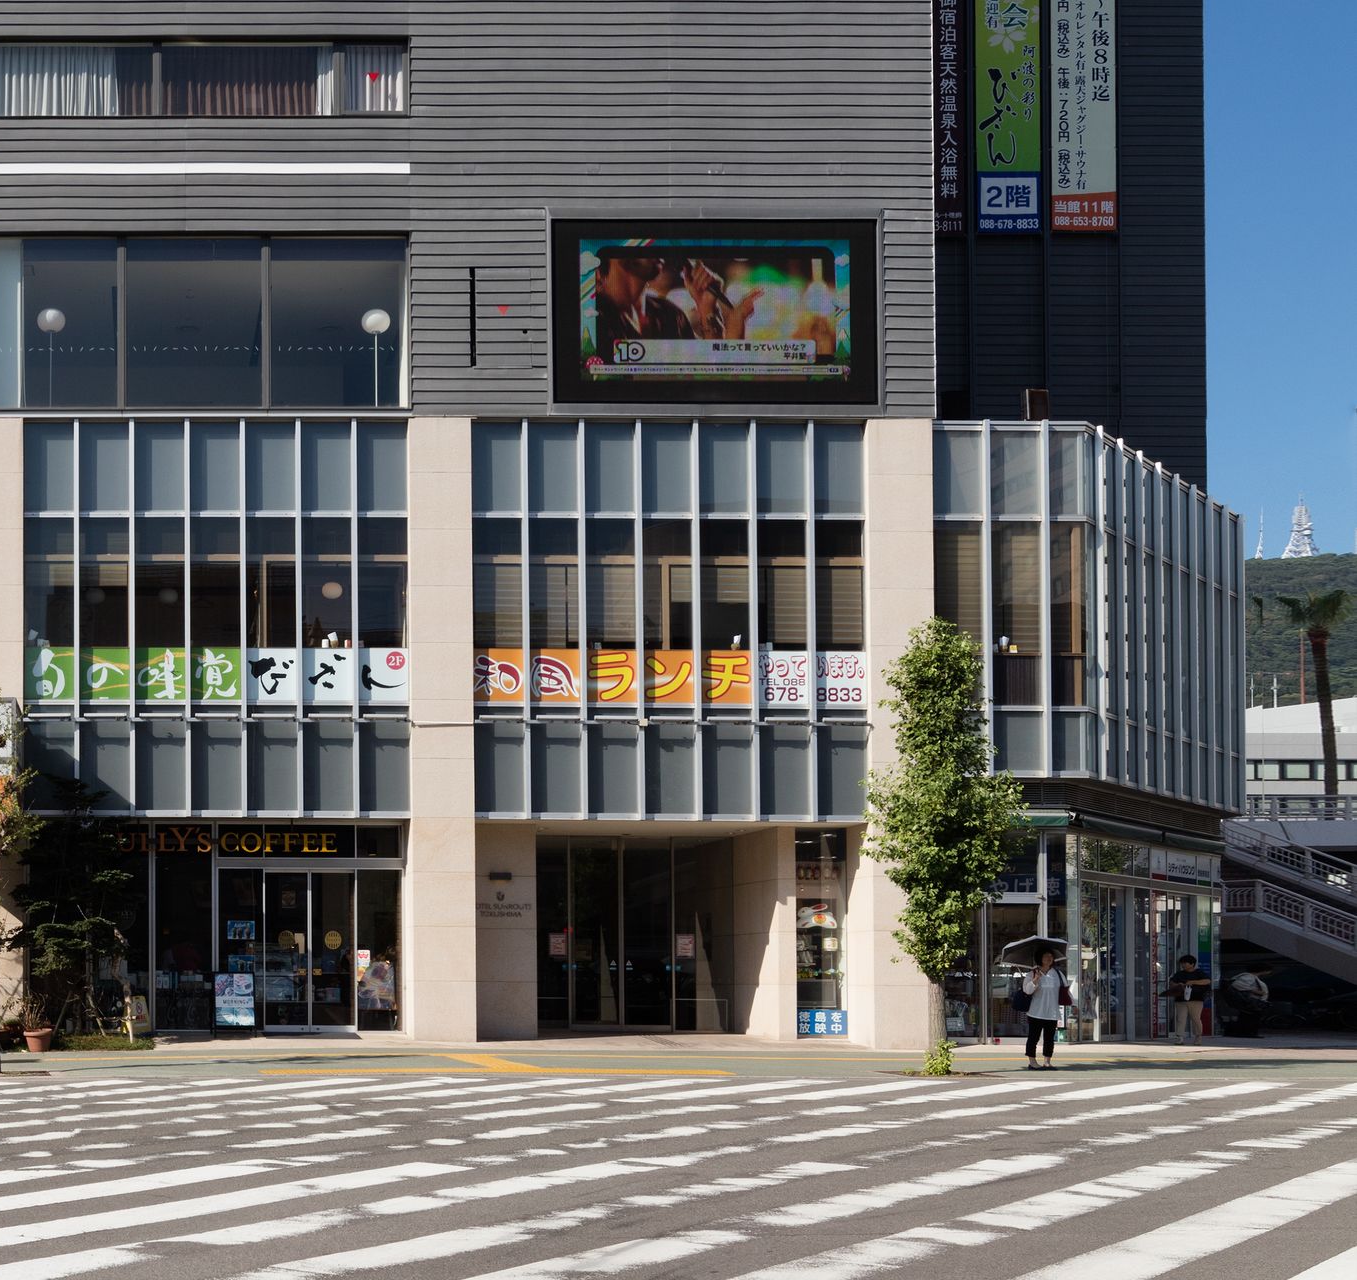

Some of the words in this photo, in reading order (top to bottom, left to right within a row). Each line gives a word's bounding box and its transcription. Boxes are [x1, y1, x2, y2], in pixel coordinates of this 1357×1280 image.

[978, 68, 1021, 166] びざん
[986, 184, 1031, 208] 2階
[1054, 201, 1114, 213] 当館11階
[980, 218, 1039, 229] 088-678-8833
[1054, 215, 1114, 226] 088-653-8760
[388, 655, 404, 666] 2F
[221, 831, 338, 853] COFFEE
[798, 1011, 843, 1023] 徳島を
[798, 1023, 843, 1035] 放映中
